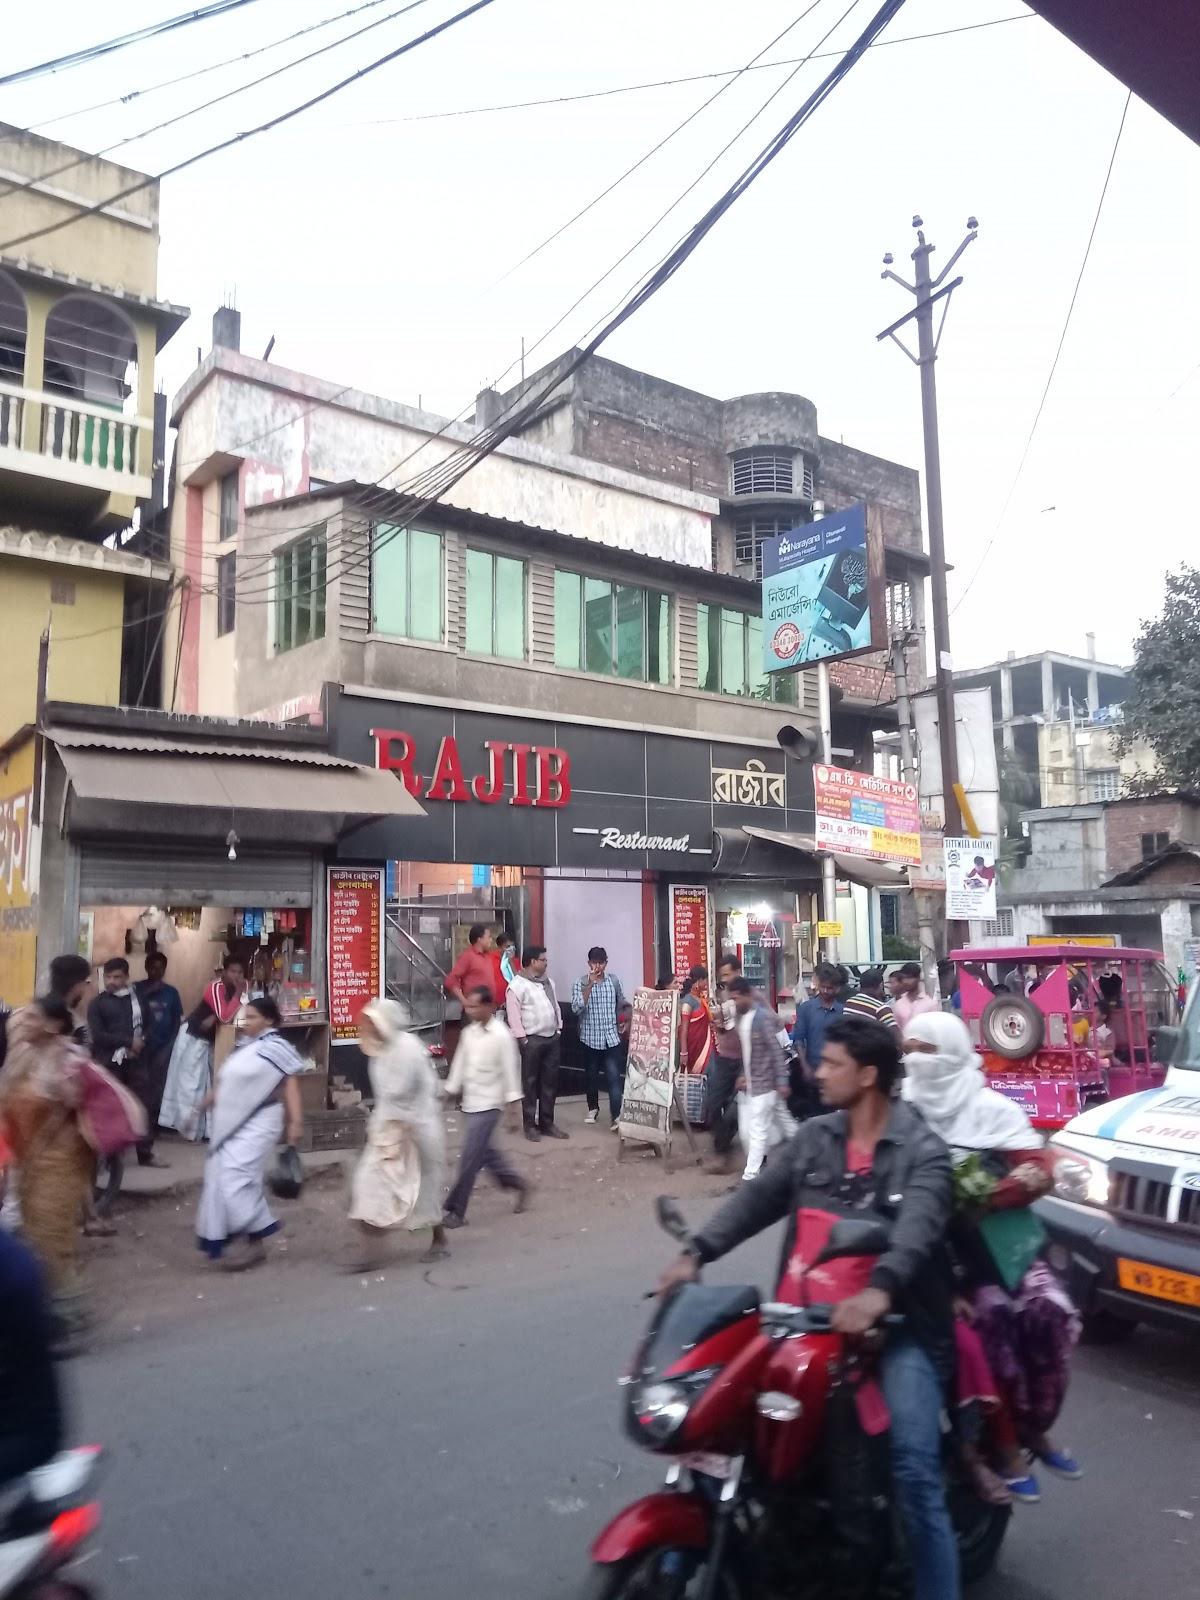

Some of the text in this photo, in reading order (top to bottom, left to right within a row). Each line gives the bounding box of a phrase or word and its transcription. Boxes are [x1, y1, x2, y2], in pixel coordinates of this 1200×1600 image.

[791, 534, 821, 551] Narayana
[768, 585, 799, 605] নিউরো
[369, 727, 573, 809] RAJIB
[712, 759, 787, 807] রাজীব
[600, 827, 690, 853] Restaurant
